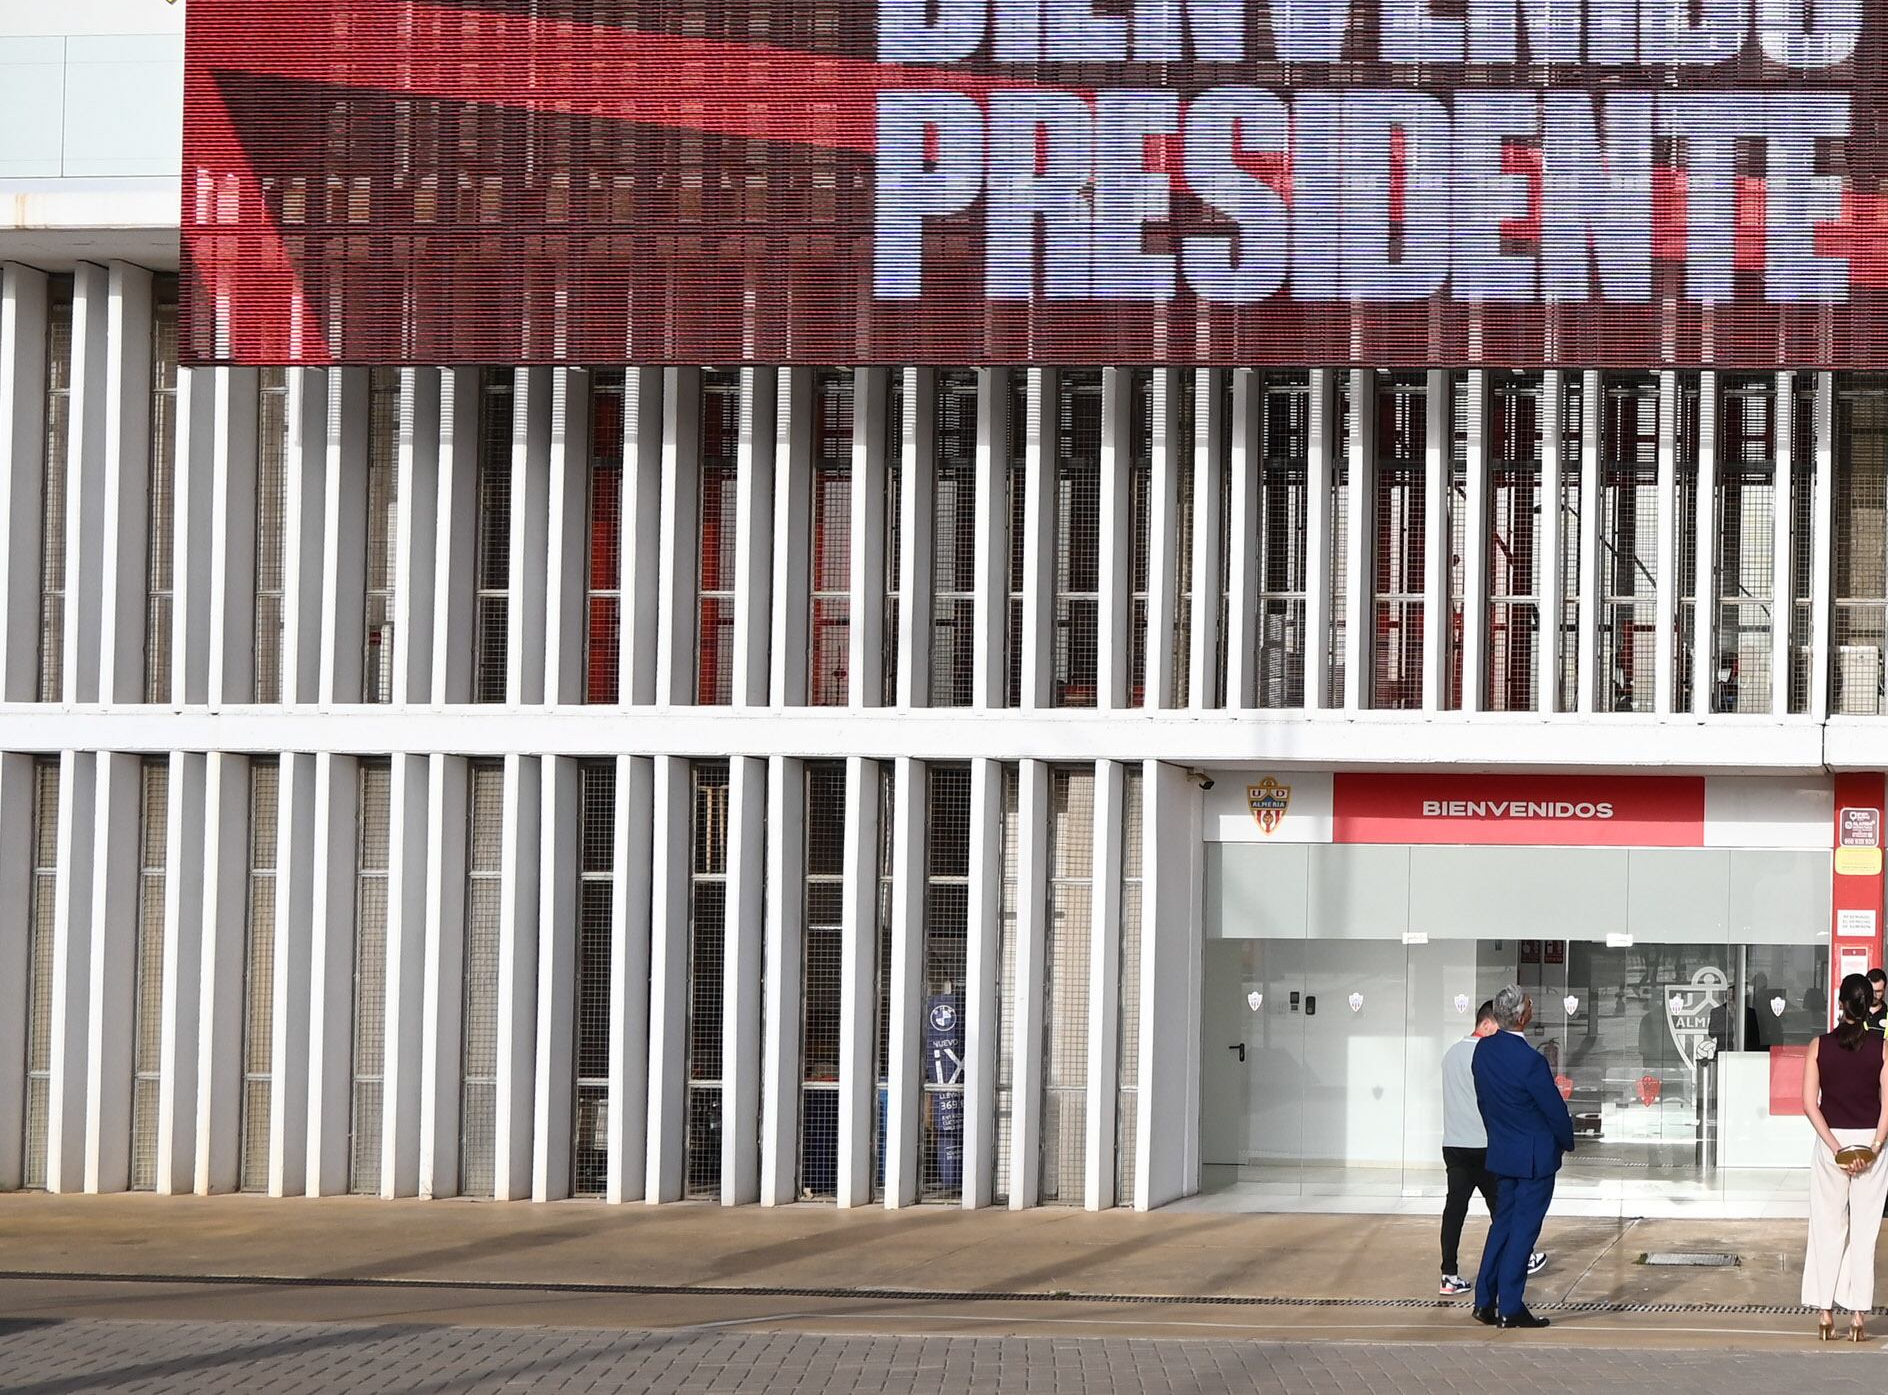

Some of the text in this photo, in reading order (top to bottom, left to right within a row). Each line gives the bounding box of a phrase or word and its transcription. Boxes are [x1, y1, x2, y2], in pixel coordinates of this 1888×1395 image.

[872, 84, 1852, 303] PRESIDENTE
[1252, 789, 1285, 797] U D
[1423, 801, 1614, 818] BIENVENIDOS
[1676, 1016, 1710, 1028] ALM
